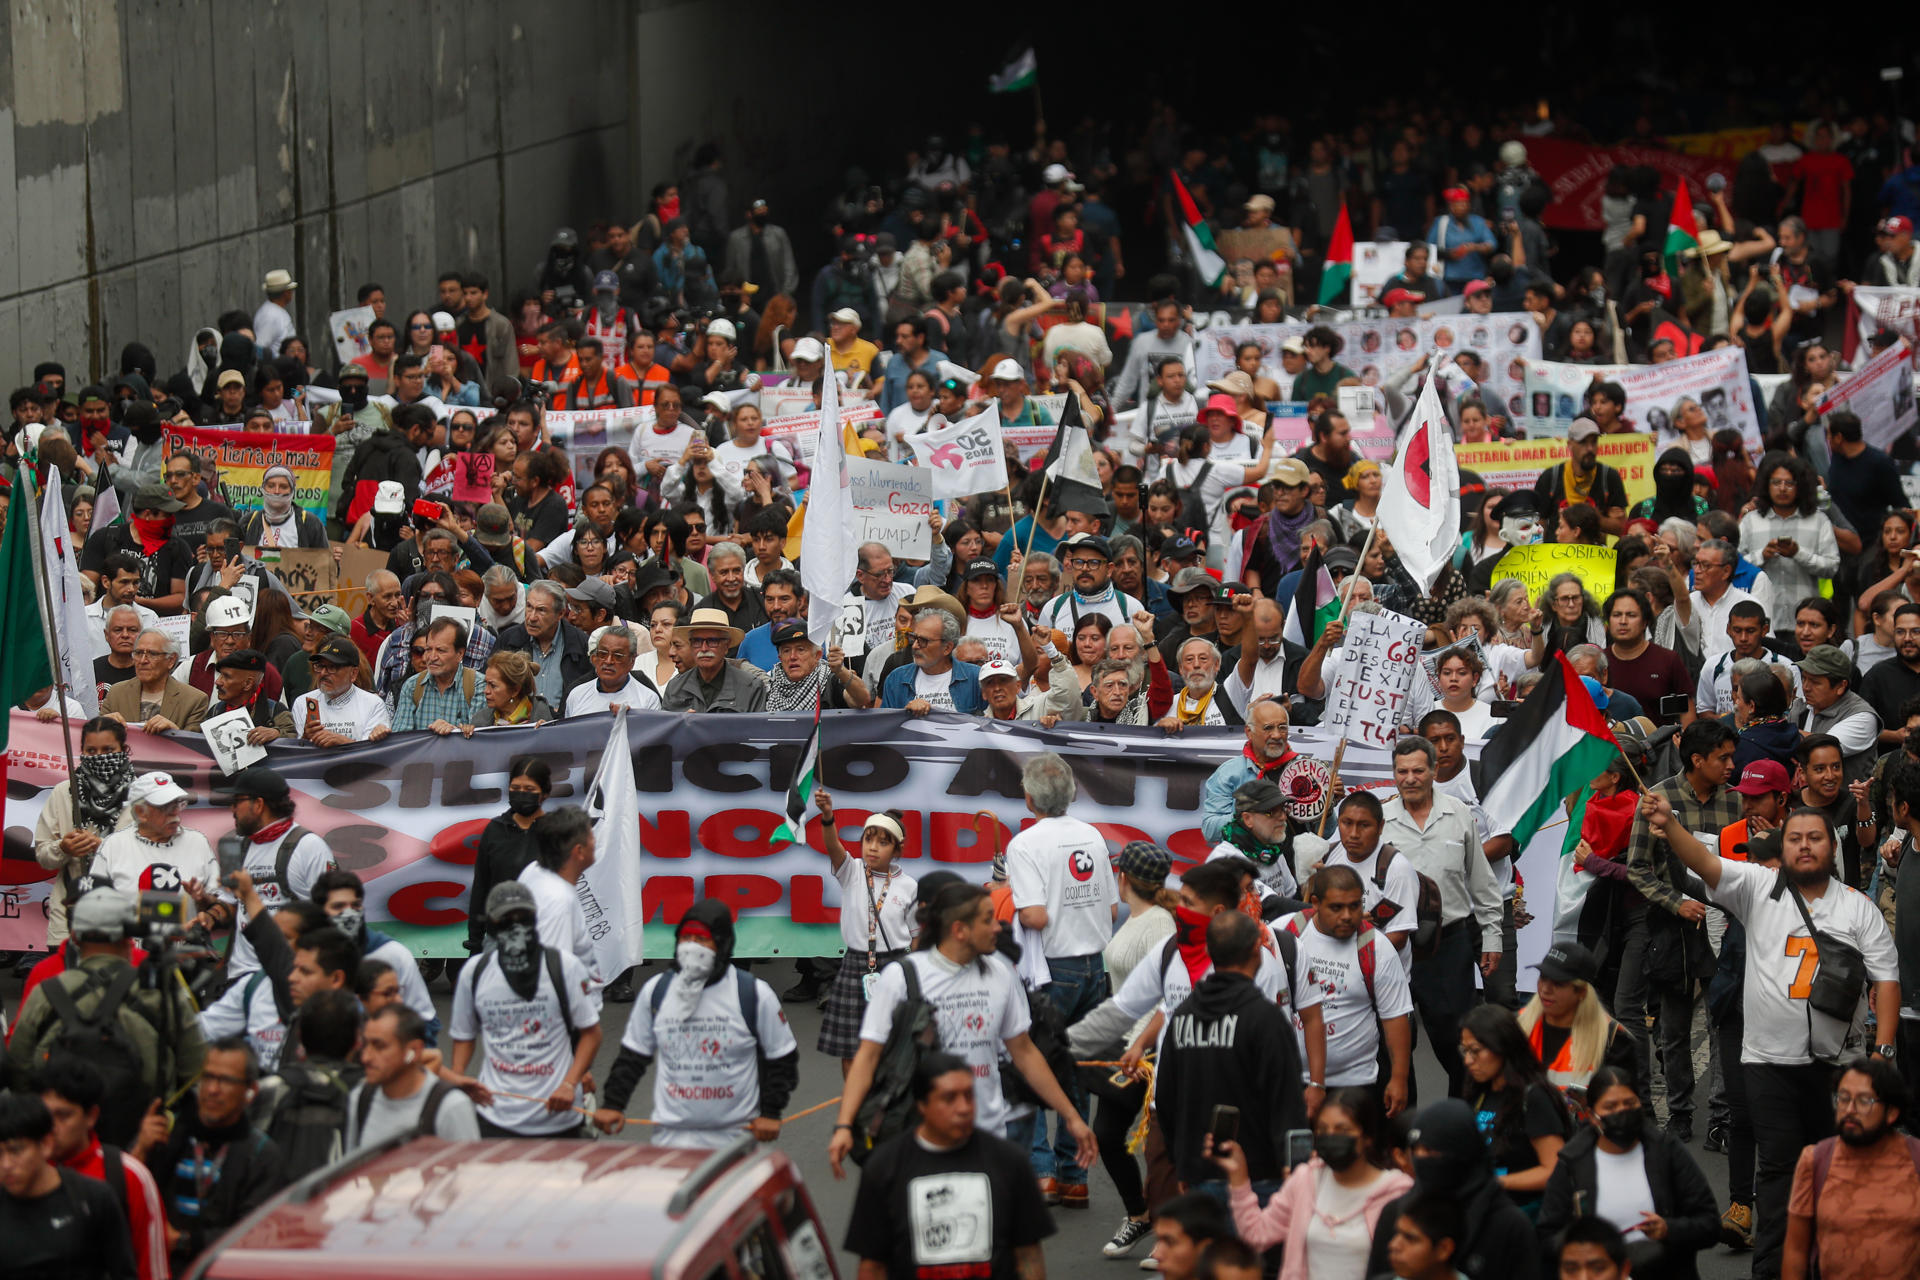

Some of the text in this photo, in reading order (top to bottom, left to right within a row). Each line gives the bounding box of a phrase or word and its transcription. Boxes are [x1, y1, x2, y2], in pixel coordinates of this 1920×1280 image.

[546, 411, 568, 423] OR
[571, 409, 604, 423] QUE
[1457, 450, 1512, 466] CRETARIO
[1513, 447, 1547, 462] OMAR
[869, 469, 922, 493] Muriendo
[887, 491, 931, 516] Gaza
[223, 606, 241, 619] 4T
[1351, 635, 1418, 665] DEL 68
[1402, 630, 1424, 647] GE
[1344, 648, 1415, 678] DESCEN
[1334, 674, 1405, 711] ¡JUST
[1359, 665, 1412, 694] EXIJ
[1338, 699, 1402, 726] EL GE
[1331, 712, 1399, 747] DE TLA
[7, 749, 62, 763] TUBRE
[1784, 934, 1821, 1000] 7
